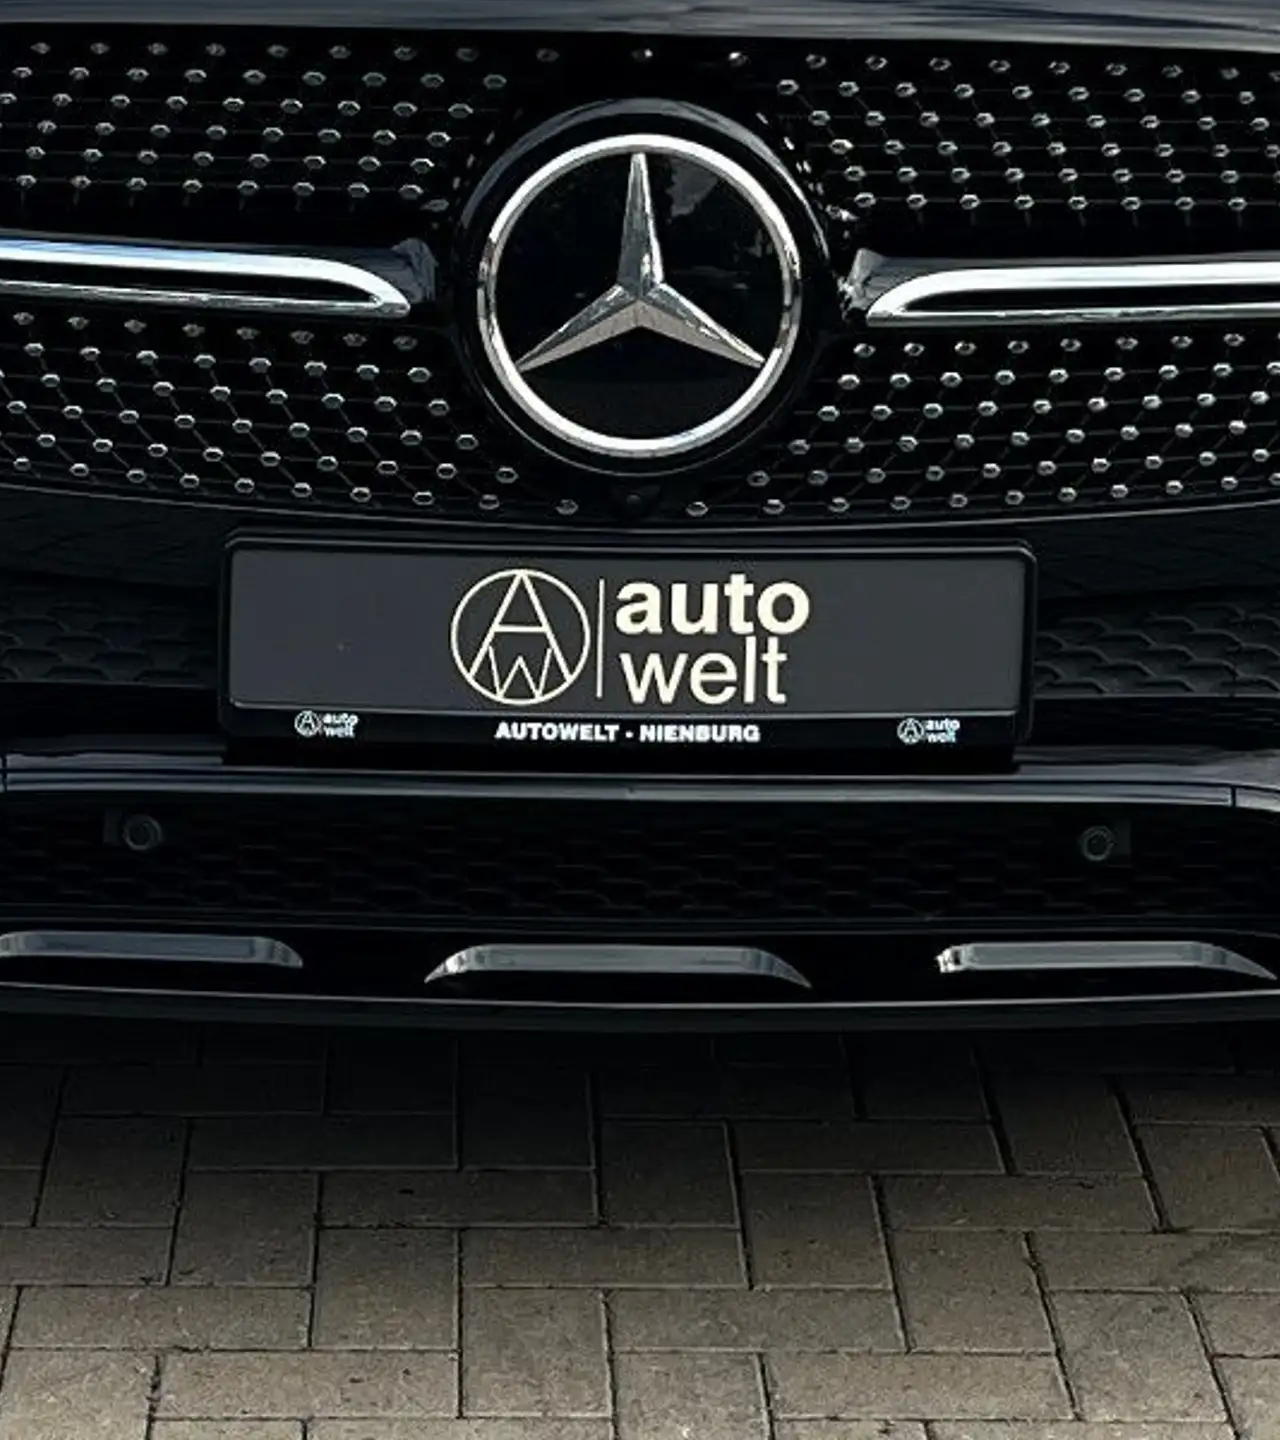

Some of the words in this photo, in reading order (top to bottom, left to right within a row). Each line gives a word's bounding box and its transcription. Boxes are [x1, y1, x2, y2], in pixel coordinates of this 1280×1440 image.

[615, 572, 811, 636] auto
[619, 635, 788, 705] welt
[323, 713, 359, 725] auto
[925, 718, 960, 731] auto
[494, 721, 620, 742] AUTOWELT
[639, 723, 762, 743] NIENBURG
